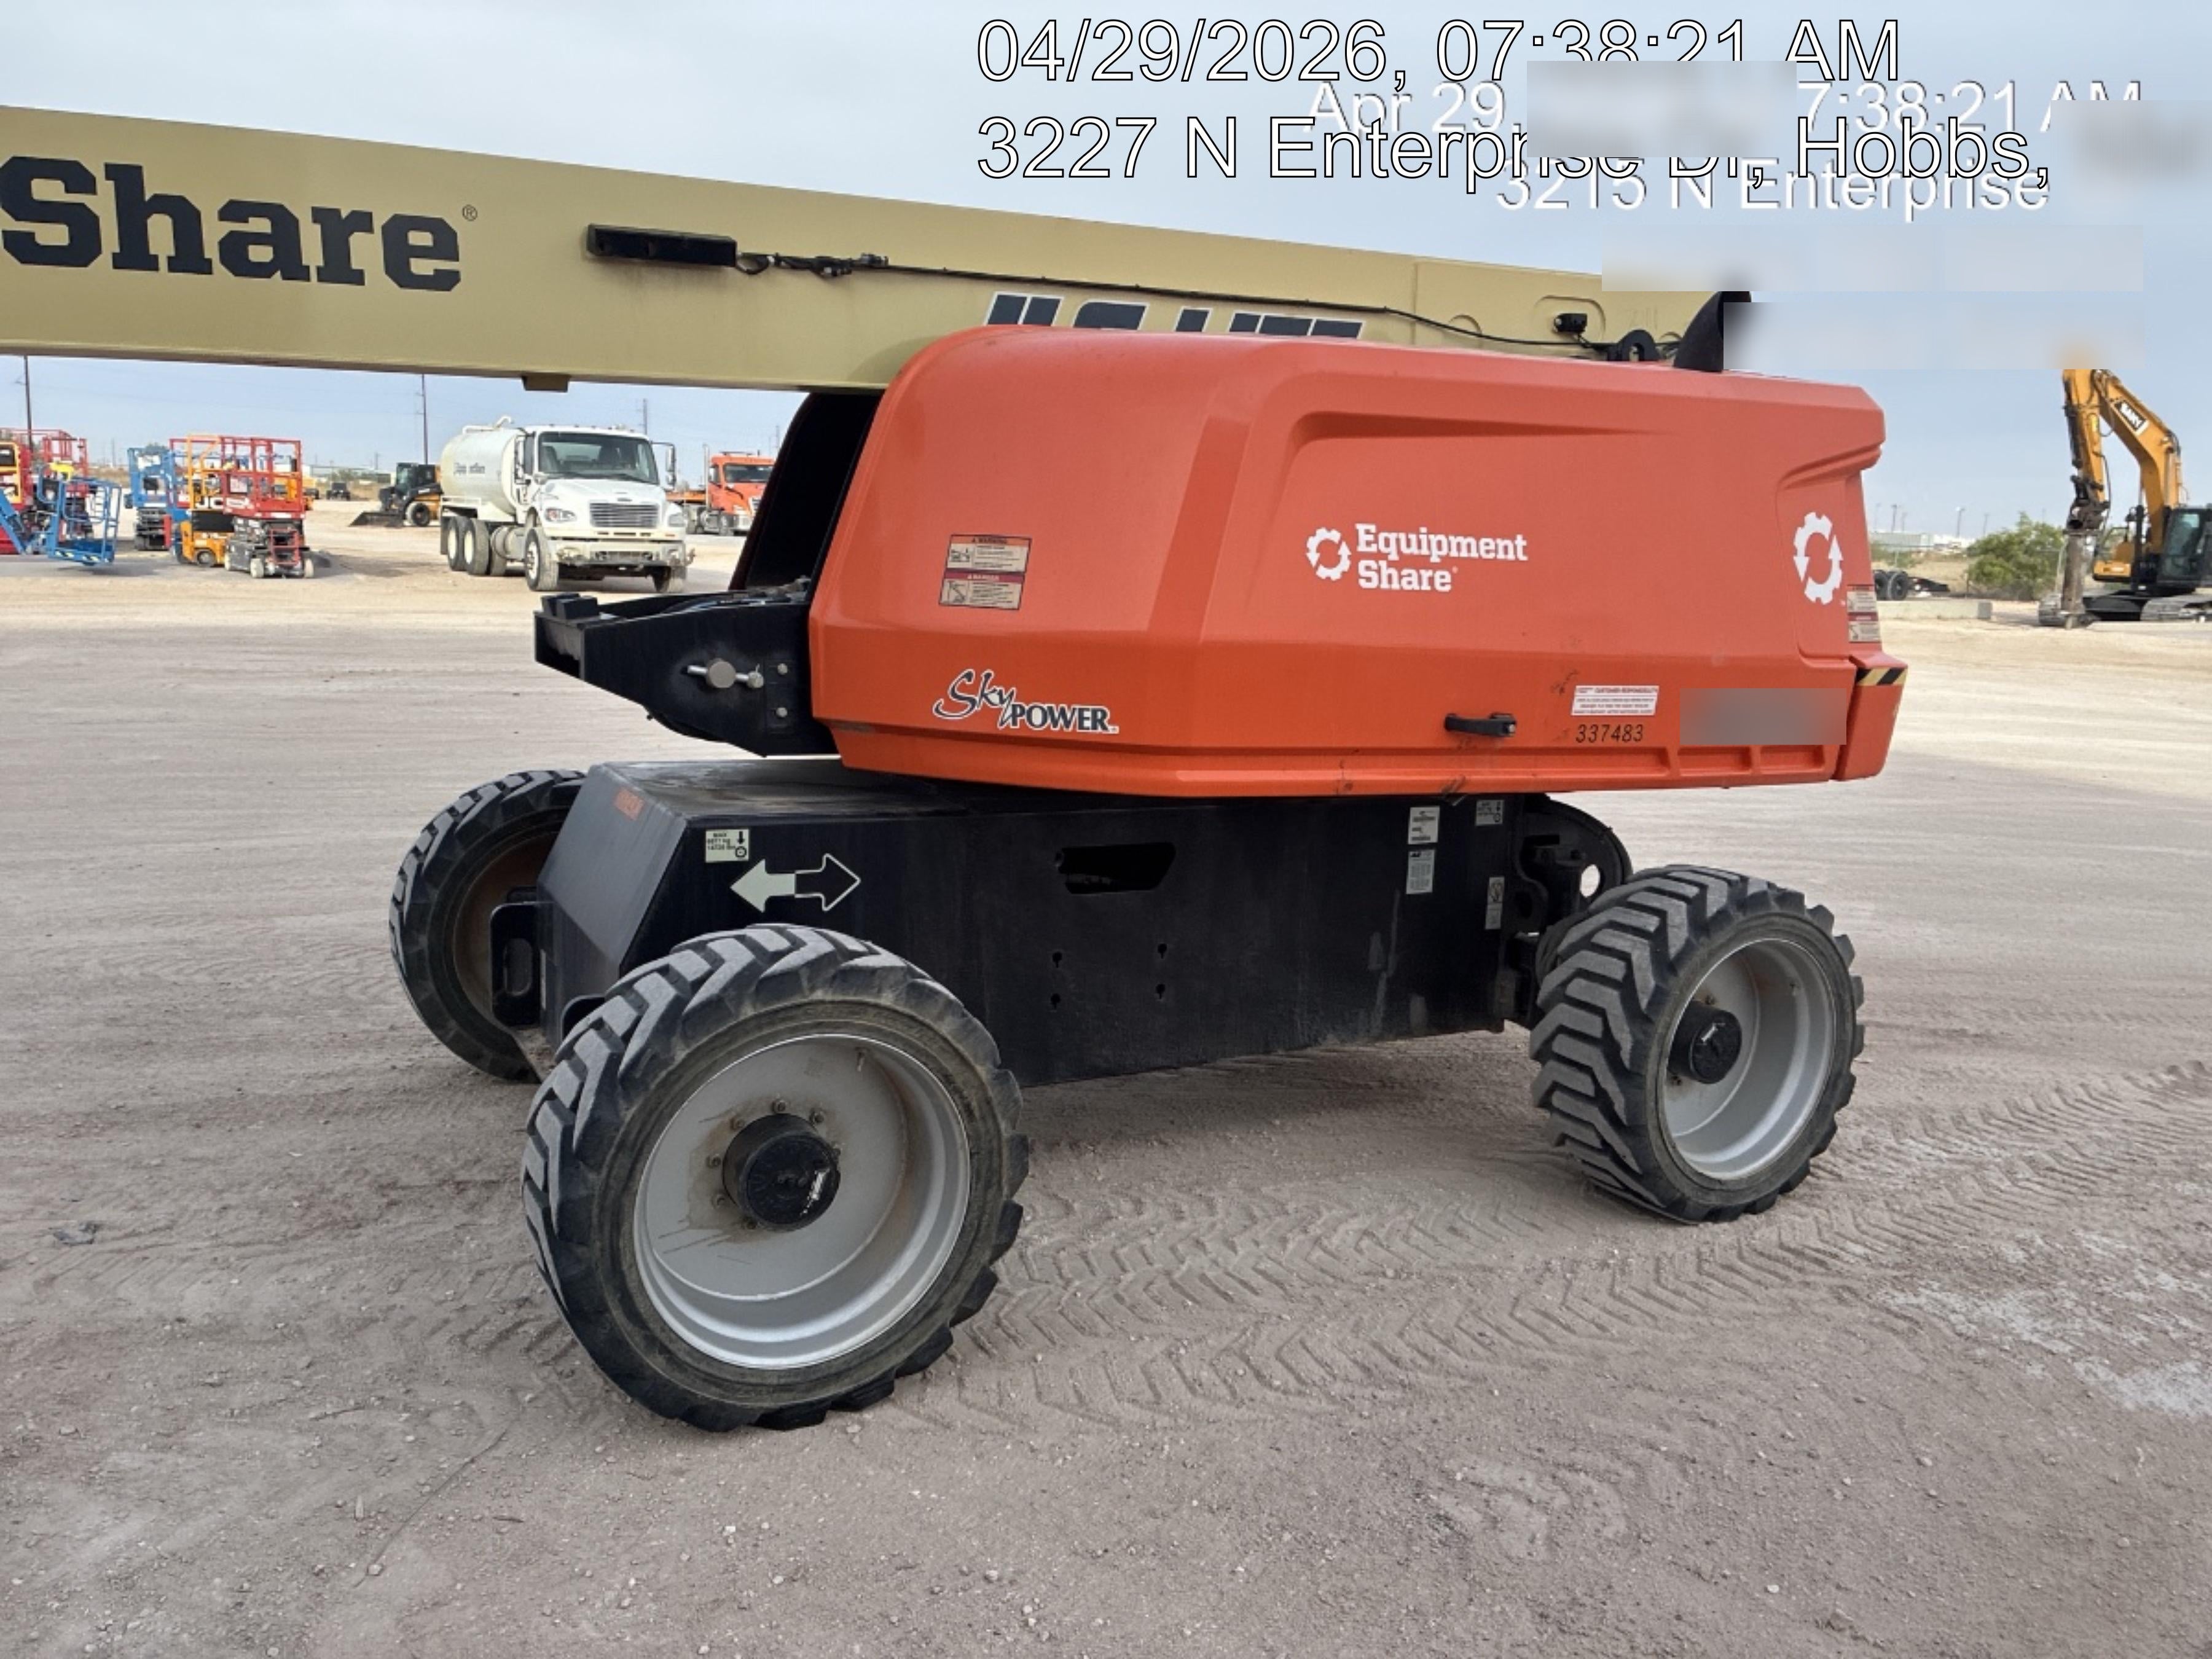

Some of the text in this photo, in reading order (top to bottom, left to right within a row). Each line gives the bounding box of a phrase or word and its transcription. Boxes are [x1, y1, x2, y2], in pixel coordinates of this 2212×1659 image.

[0, 156, 462, 292] Share
[1355, 523, 1528, 563] Equipment
[1358, 560, 1453, 592] Share
[1575, 724, 1644, 743] 337483
